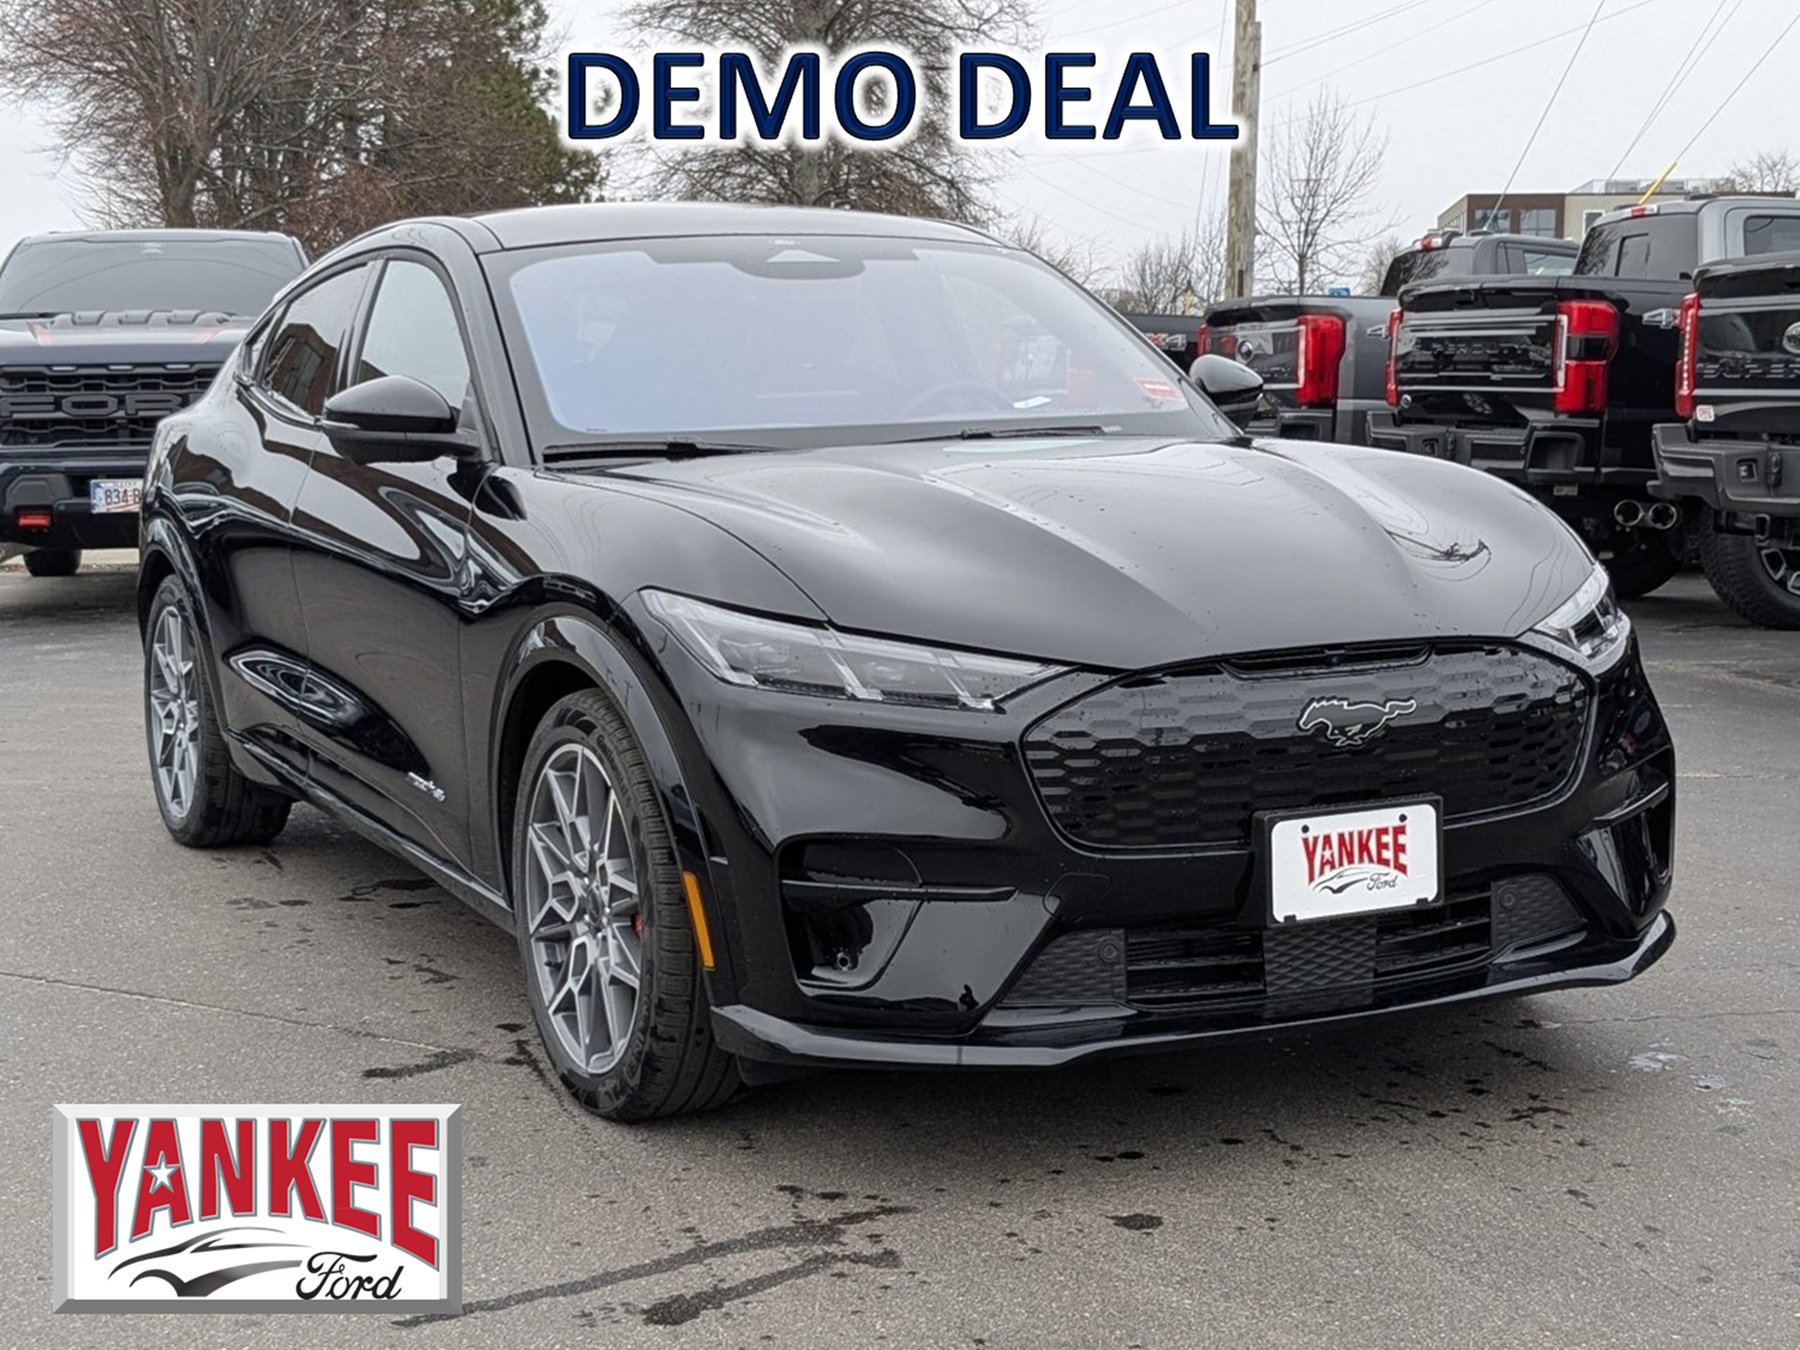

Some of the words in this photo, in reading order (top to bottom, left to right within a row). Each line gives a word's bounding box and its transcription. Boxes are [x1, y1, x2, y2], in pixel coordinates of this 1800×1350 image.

[1146, 333, 1188, 351] X4
[0, 393, 205, 417] FOR
[1301, 824, 1408, 885] YANKEE
[1366, 872, 1398, 891] Ford
